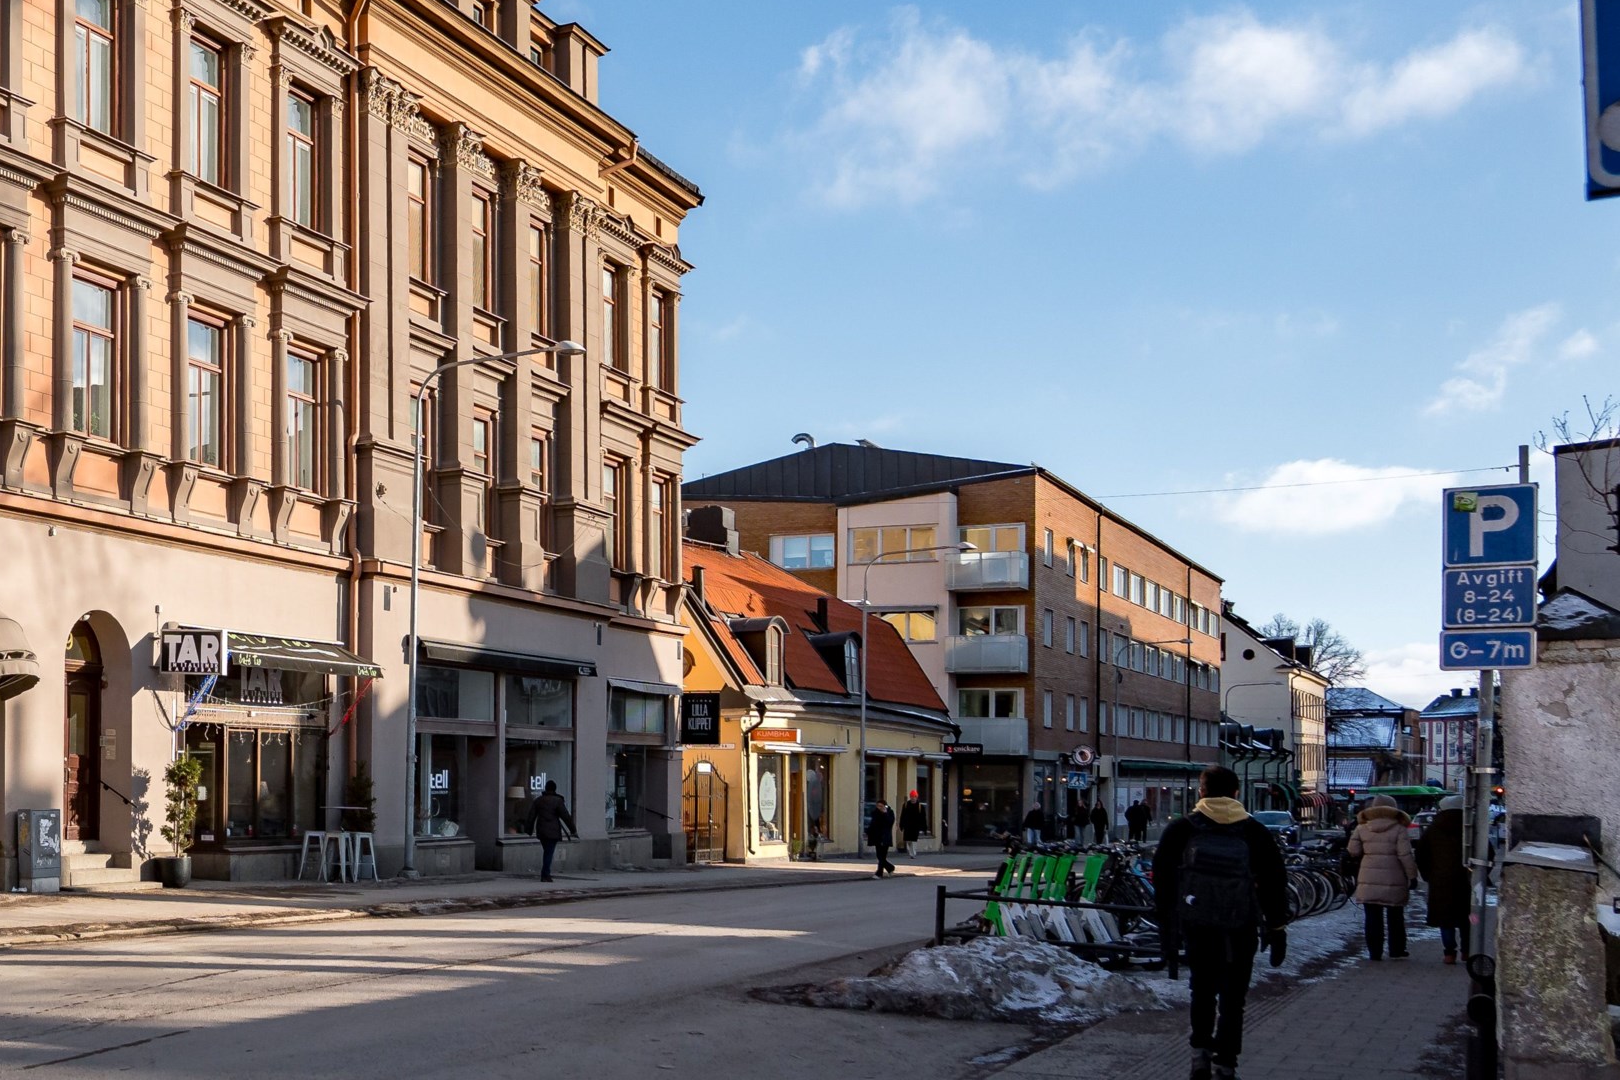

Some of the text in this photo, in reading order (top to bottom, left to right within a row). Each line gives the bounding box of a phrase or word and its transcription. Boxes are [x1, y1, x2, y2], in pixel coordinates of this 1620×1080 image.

[1469, 494, 1520, 558] P
[1456, 571, 1524, 588] Avgift
[1463, 589, 1515, 604] 8-24
[1456, 606, 1523, 624] (8-24)
[163, 634, 220, 664] TAR
[691, 703, 709, 717] LILLA
[687, 717, 712, 731] KLIPPET
[756, 730, 790, 738] KUMBHA
[429, 769, 449, 789] tell
[530, 772, 547, 791] tell
